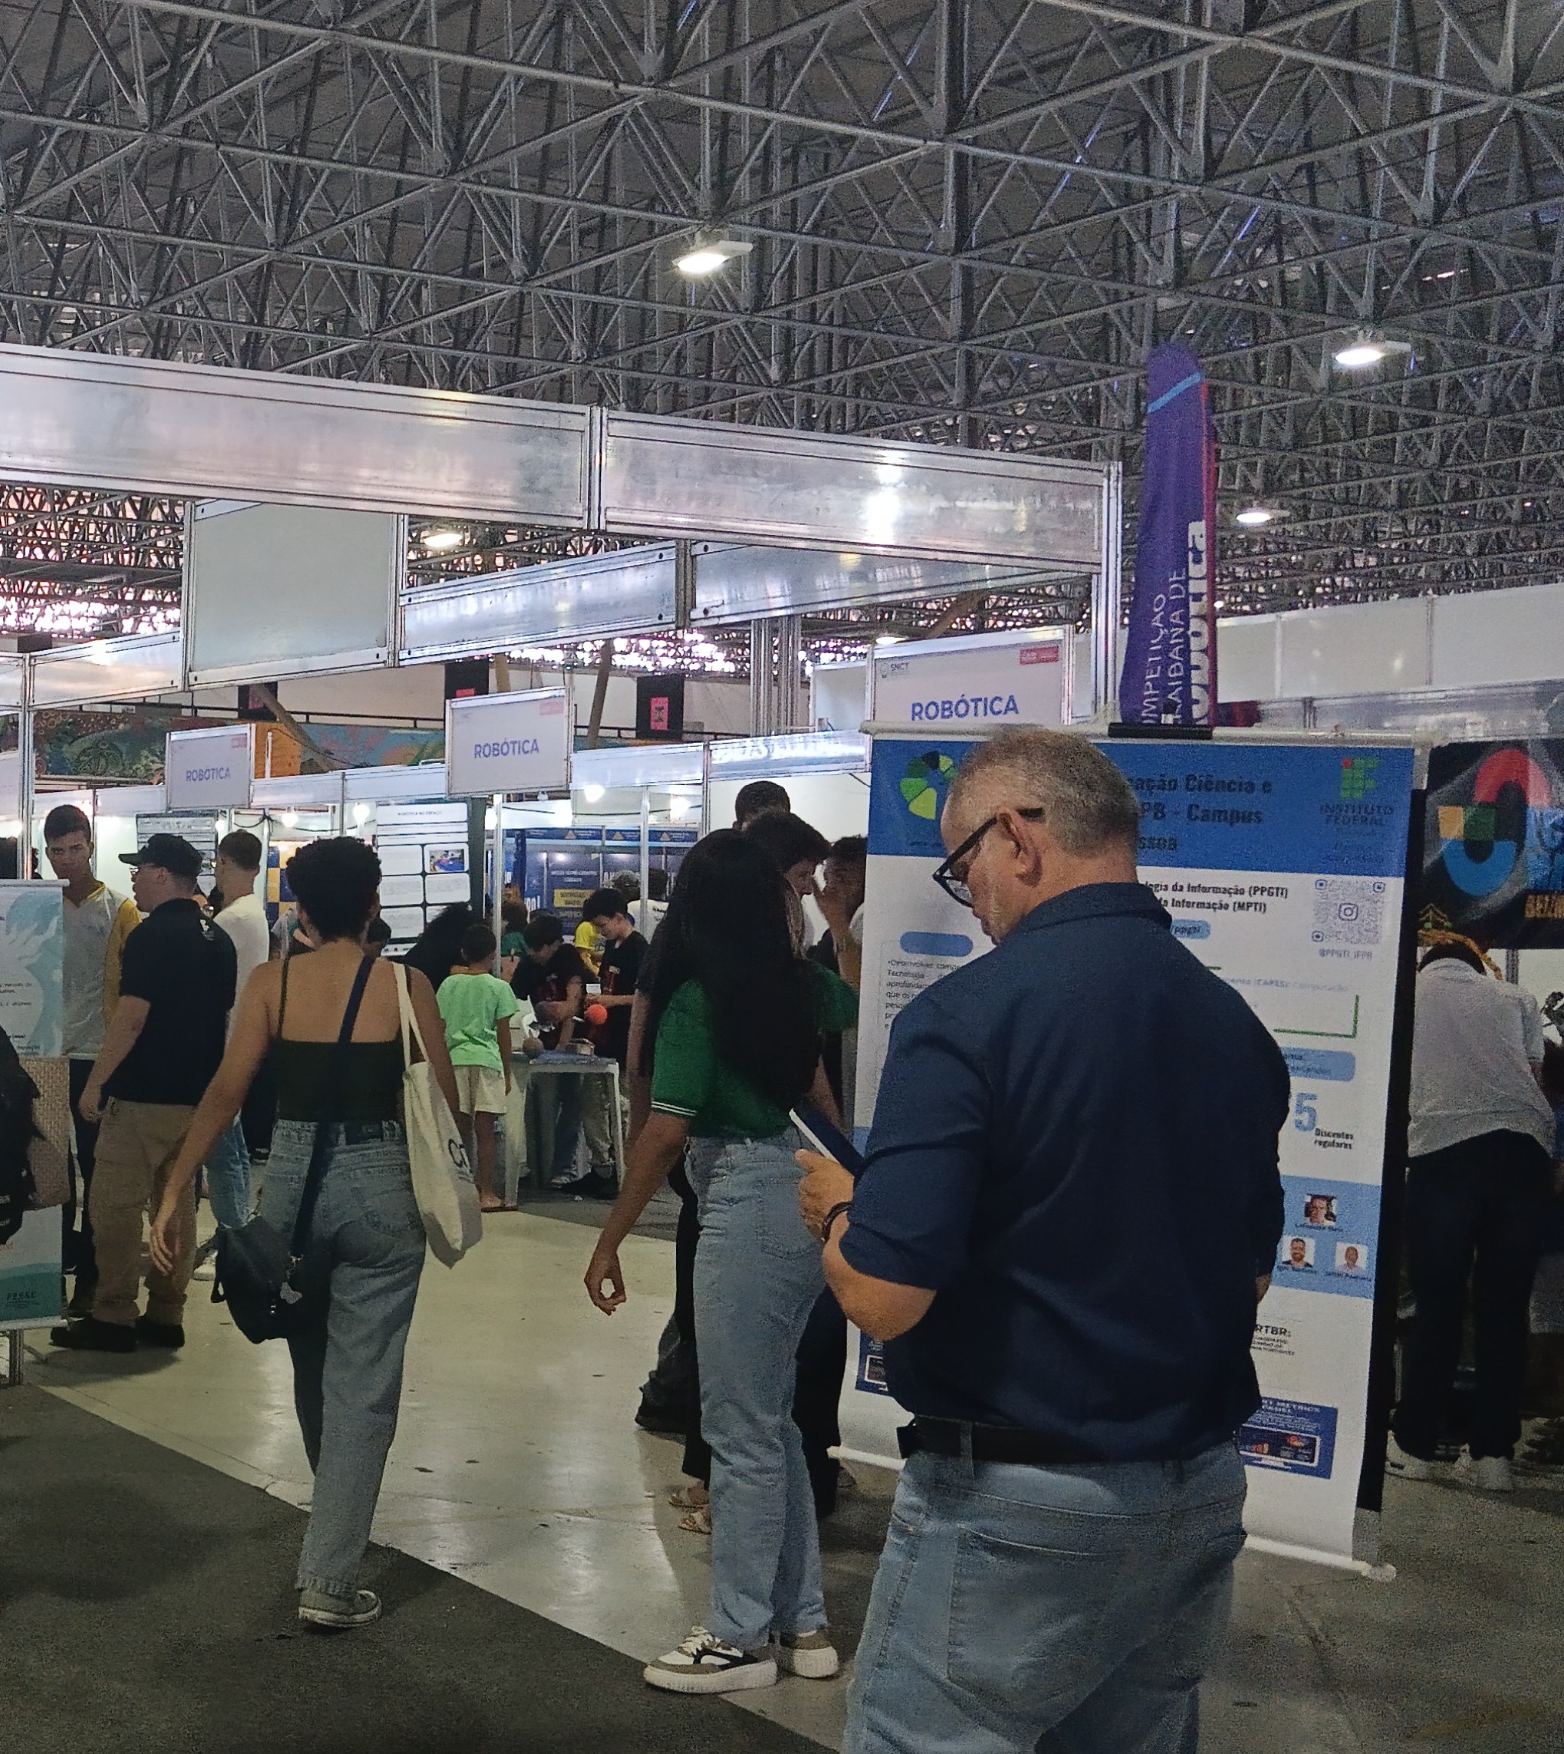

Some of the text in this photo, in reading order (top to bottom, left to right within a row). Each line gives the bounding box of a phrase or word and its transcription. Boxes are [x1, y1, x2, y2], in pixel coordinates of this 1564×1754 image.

[911, 694, 1019, 721] ROBÓTICA
[474, 737, 540, 759] ROBÓTICA
[1185, 774, 1256, 794] Ciência
[1261, 781, 1273, 794] e
[1186, 803, 1264, 827] Campus
[1172, 881, 1184, 892] da
[1187, 882, 1246, 897] Informação
[1248, 885, 1289, 899] (PPGTI)
[1171, 897, 1230, 913] Informação
[1232, 901, 1267, 914] (MPTI)
[1294, 1092, 1318, 1132] 5
[1314, 1127, 1354, 1140] Discentes
[1313, 1138, 1353, 1151] regulares
